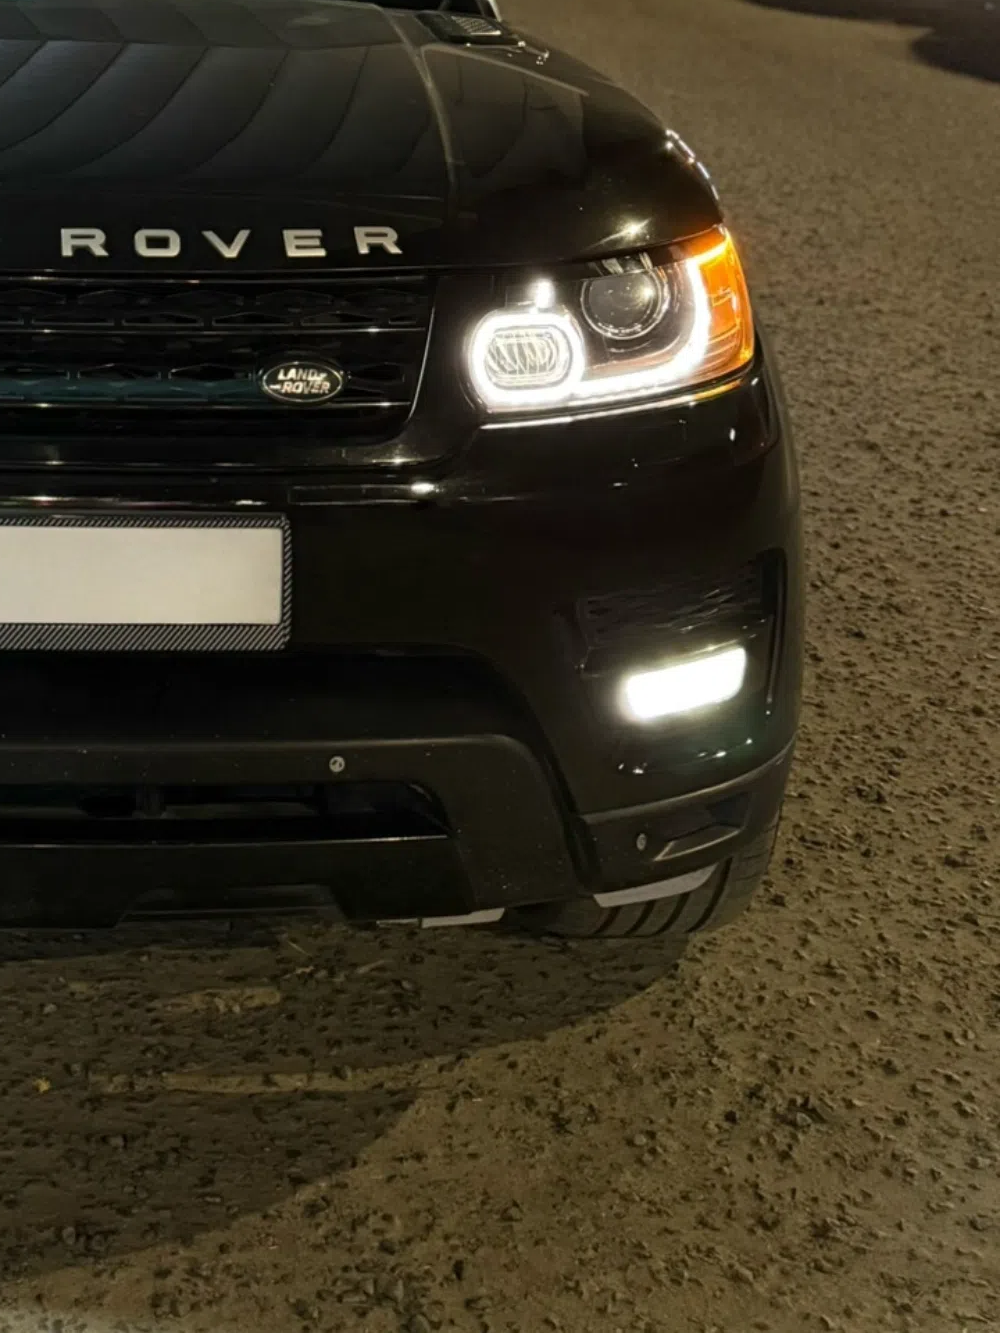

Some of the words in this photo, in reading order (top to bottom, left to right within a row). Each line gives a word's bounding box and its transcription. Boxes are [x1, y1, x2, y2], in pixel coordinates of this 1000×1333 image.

[60, 225, 402, 259] ROVER
[278, 368, 320, 381] LAND
[281, 380, 331, 394] ROVER
